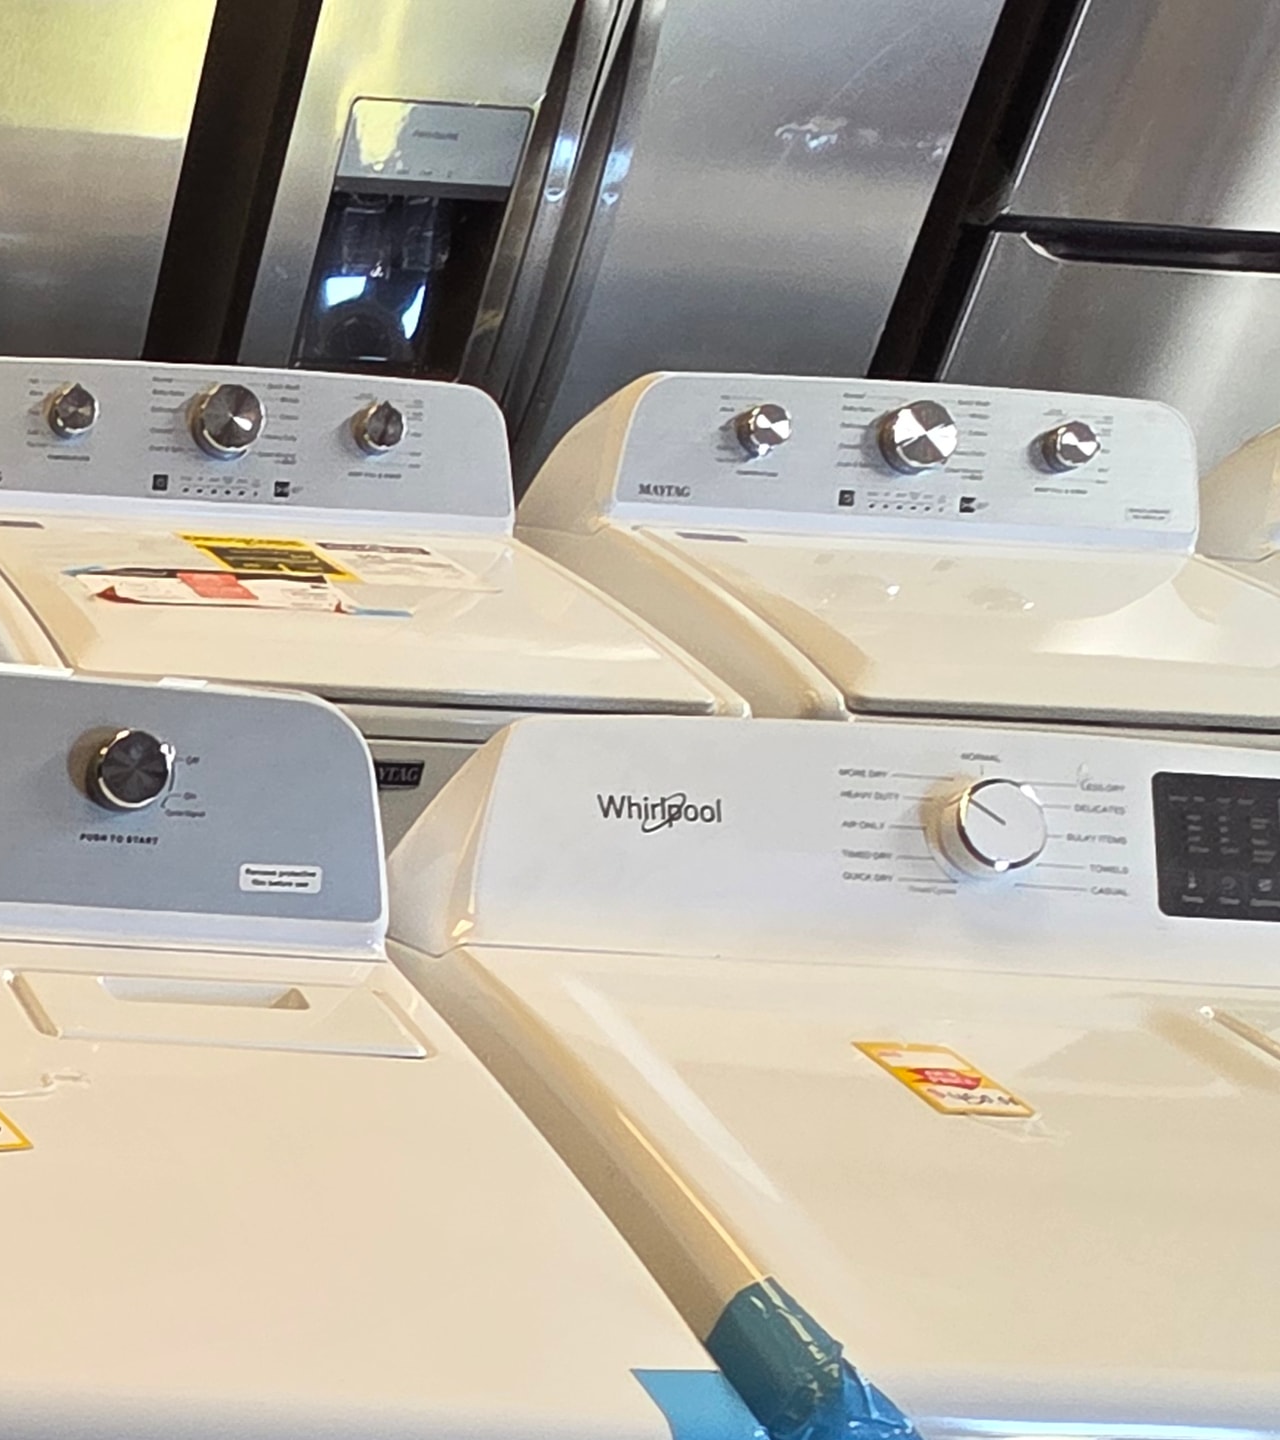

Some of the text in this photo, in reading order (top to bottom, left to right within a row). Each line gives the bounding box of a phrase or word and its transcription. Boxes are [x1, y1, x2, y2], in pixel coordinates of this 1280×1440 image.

[638, 483, 691, 499] MAYTAG
[379, 767, 419, 782] YTAG
[597, 793, 722, 831] Whirlpool
